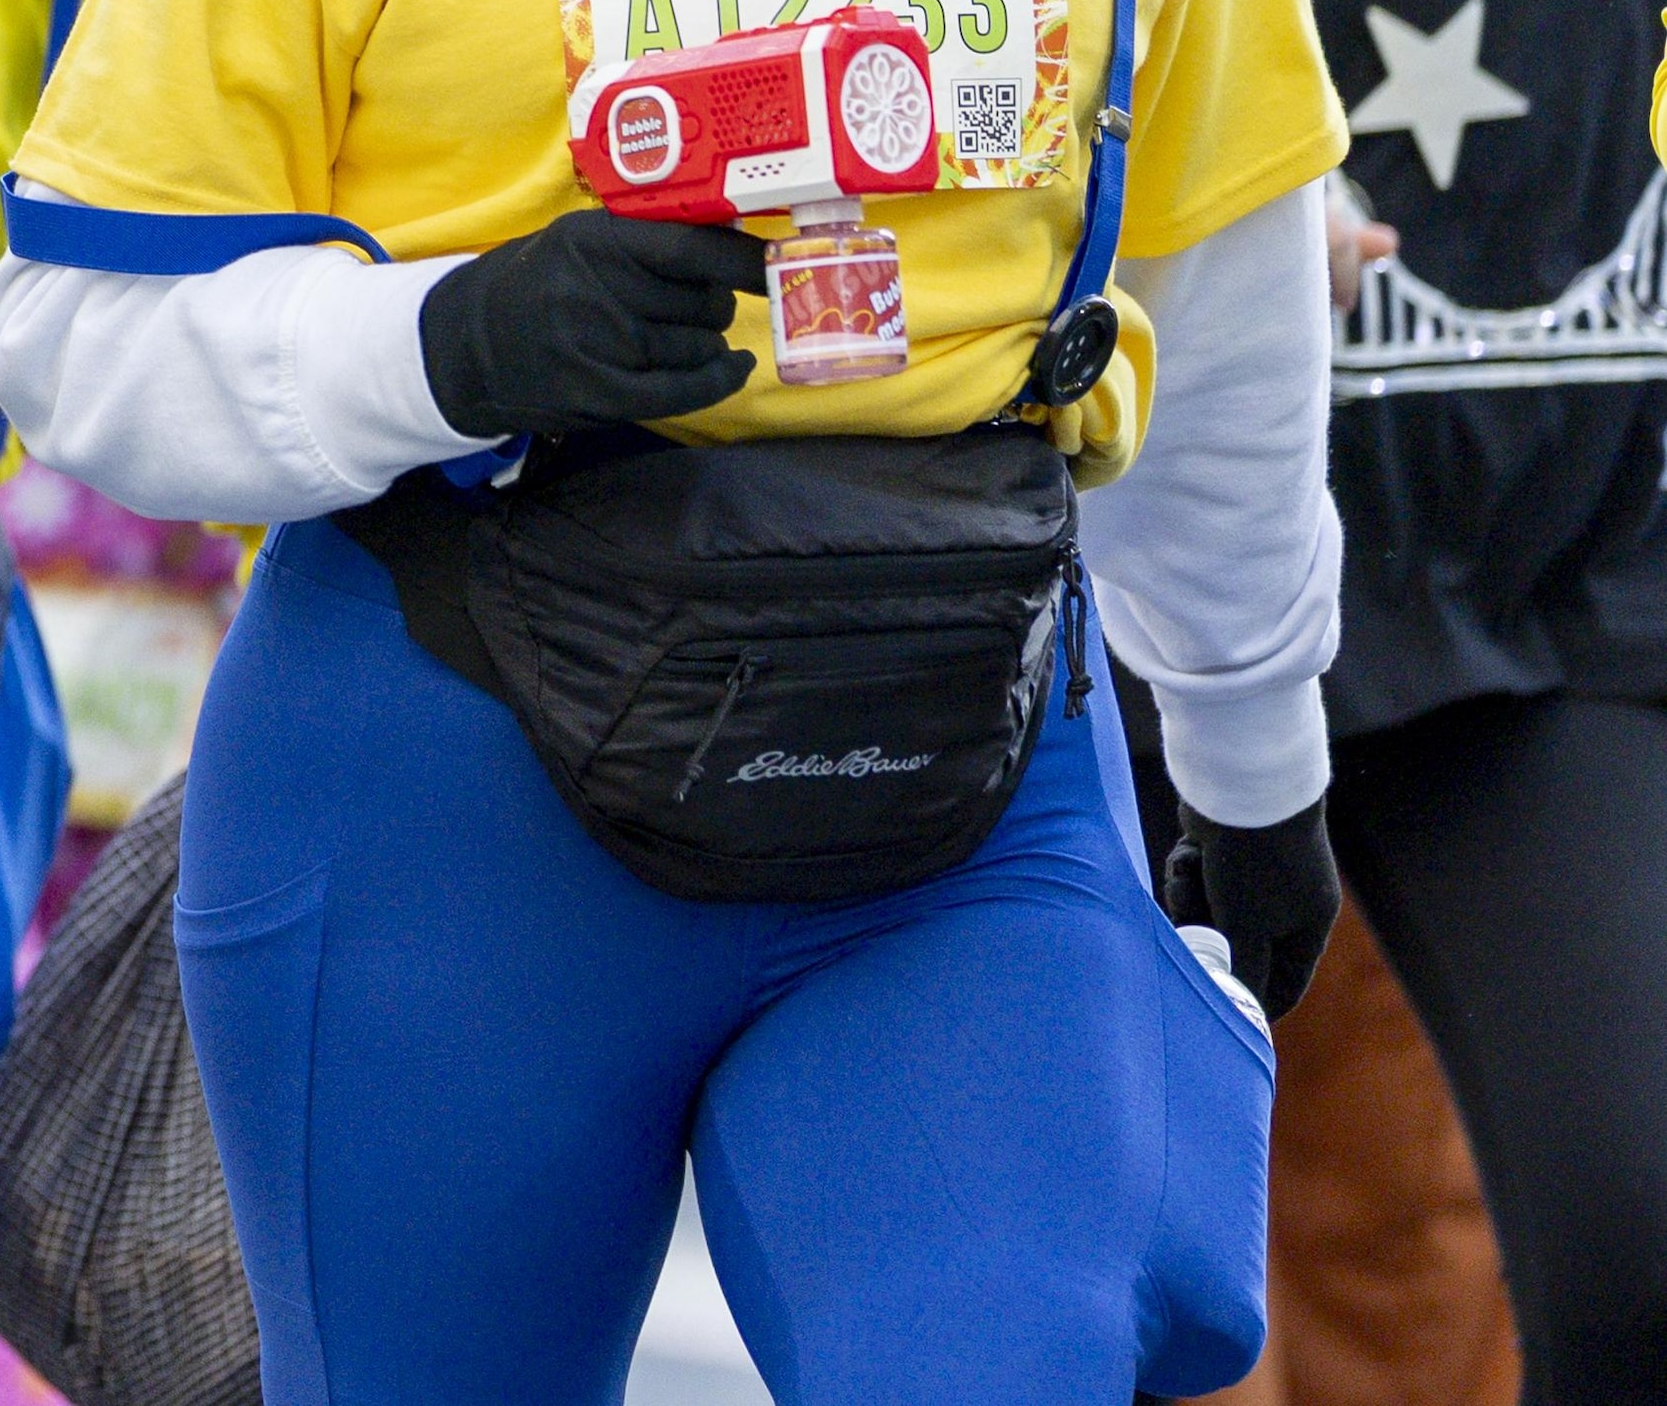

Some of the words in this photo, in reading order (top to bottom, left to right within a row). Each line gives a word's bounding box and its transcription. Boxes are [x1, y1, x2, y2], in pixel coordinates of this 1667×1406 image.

[621, 117, 662, 137] Bubble
[620, 134, 670, 154] machine
[727, 750, 843, 783] Eddie
[838, 746, 939, 776] Bauer
